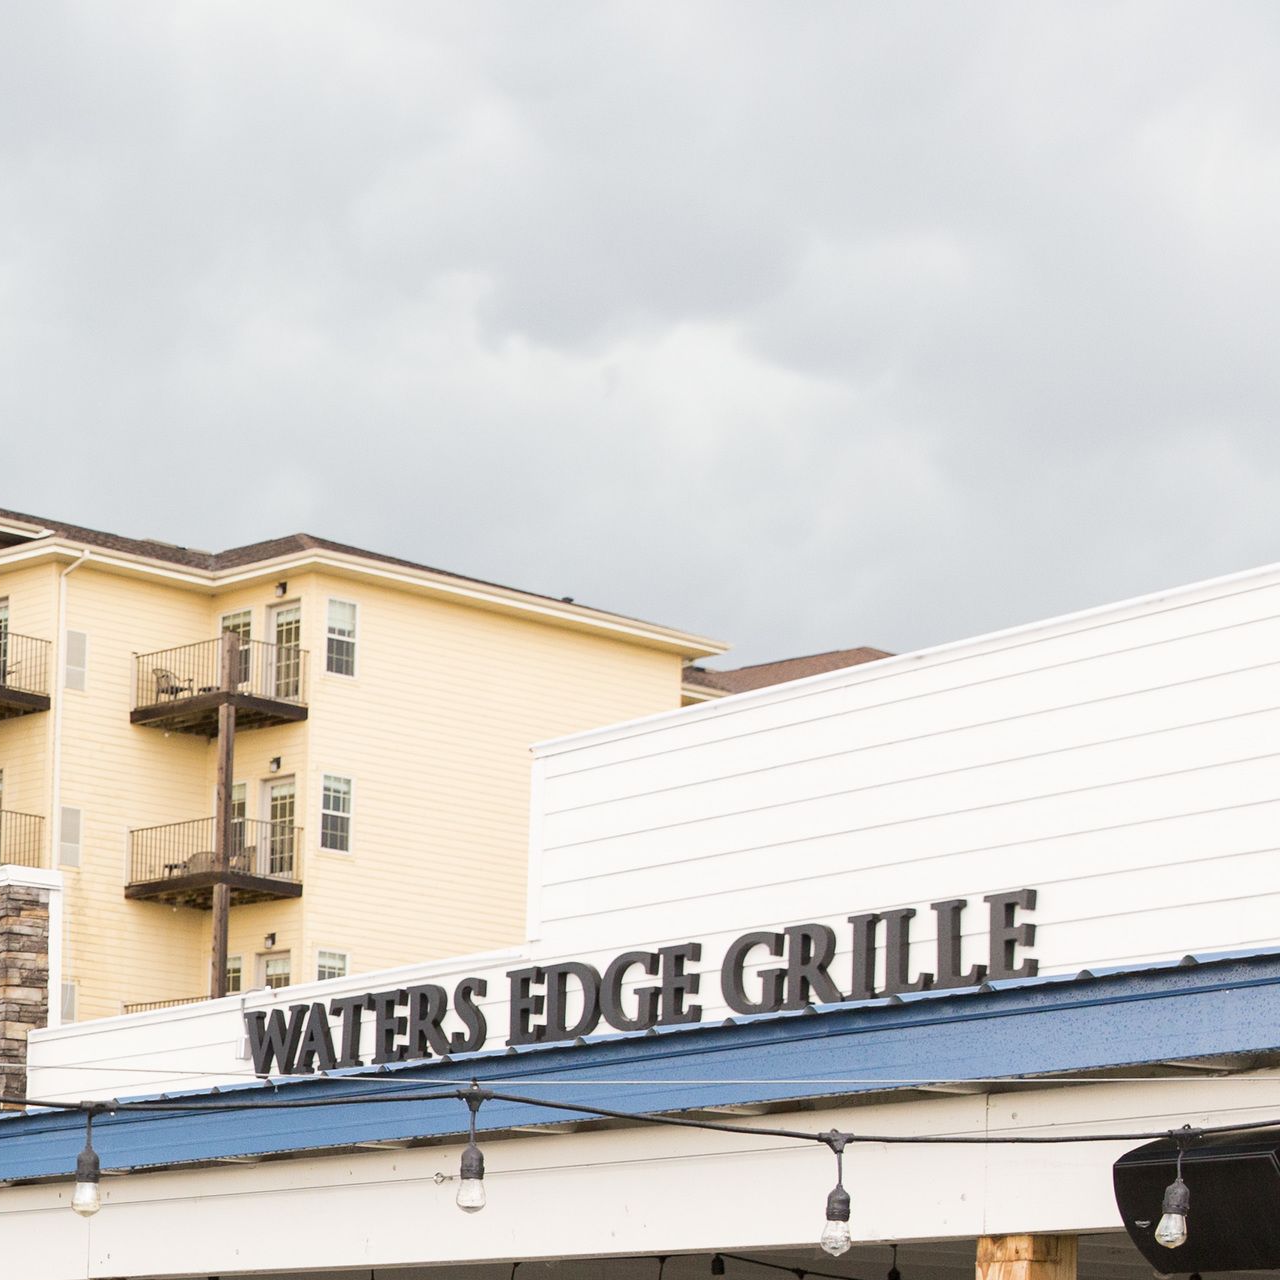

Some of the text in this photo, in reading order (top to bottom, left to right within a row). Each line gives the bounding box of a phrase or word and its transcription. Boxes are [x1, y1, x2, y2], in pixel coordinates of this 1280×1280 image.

[244, 887, 1039, 1080] WATERS EDGE GRILLE
